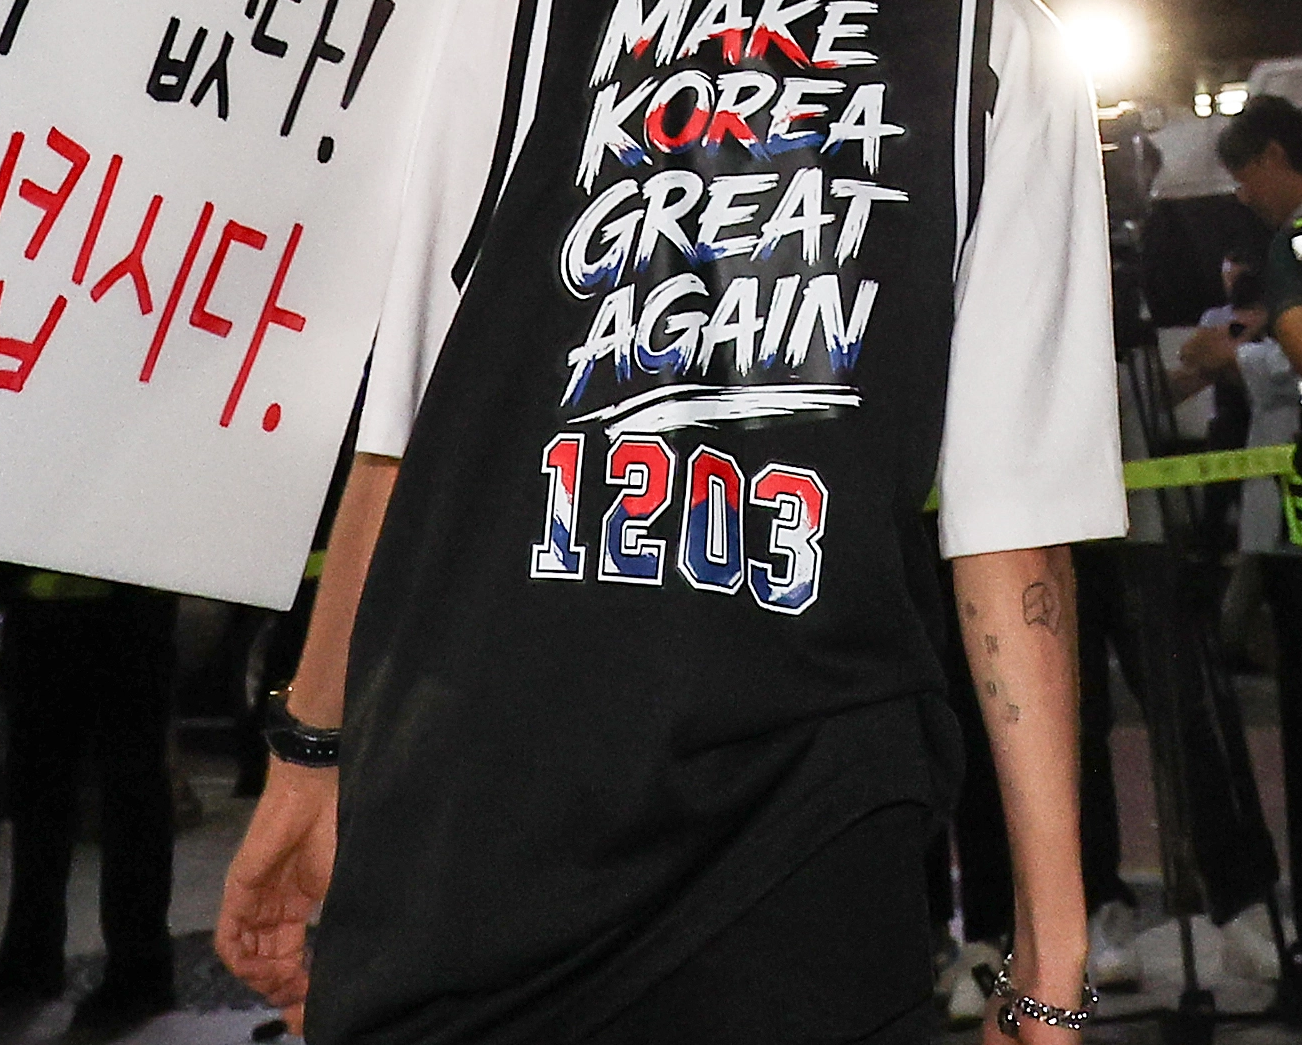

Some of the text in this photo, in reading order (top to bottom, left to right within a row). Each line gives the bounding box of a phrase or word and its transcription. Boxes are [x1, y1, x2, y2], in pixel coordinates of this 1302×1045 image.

[577, 68, 905, 194] KOREA
[561, 167, 909, 298] GREAT
[560, 273, 879, 407] AGAIN
[530, 432, 829, 615] 1203
